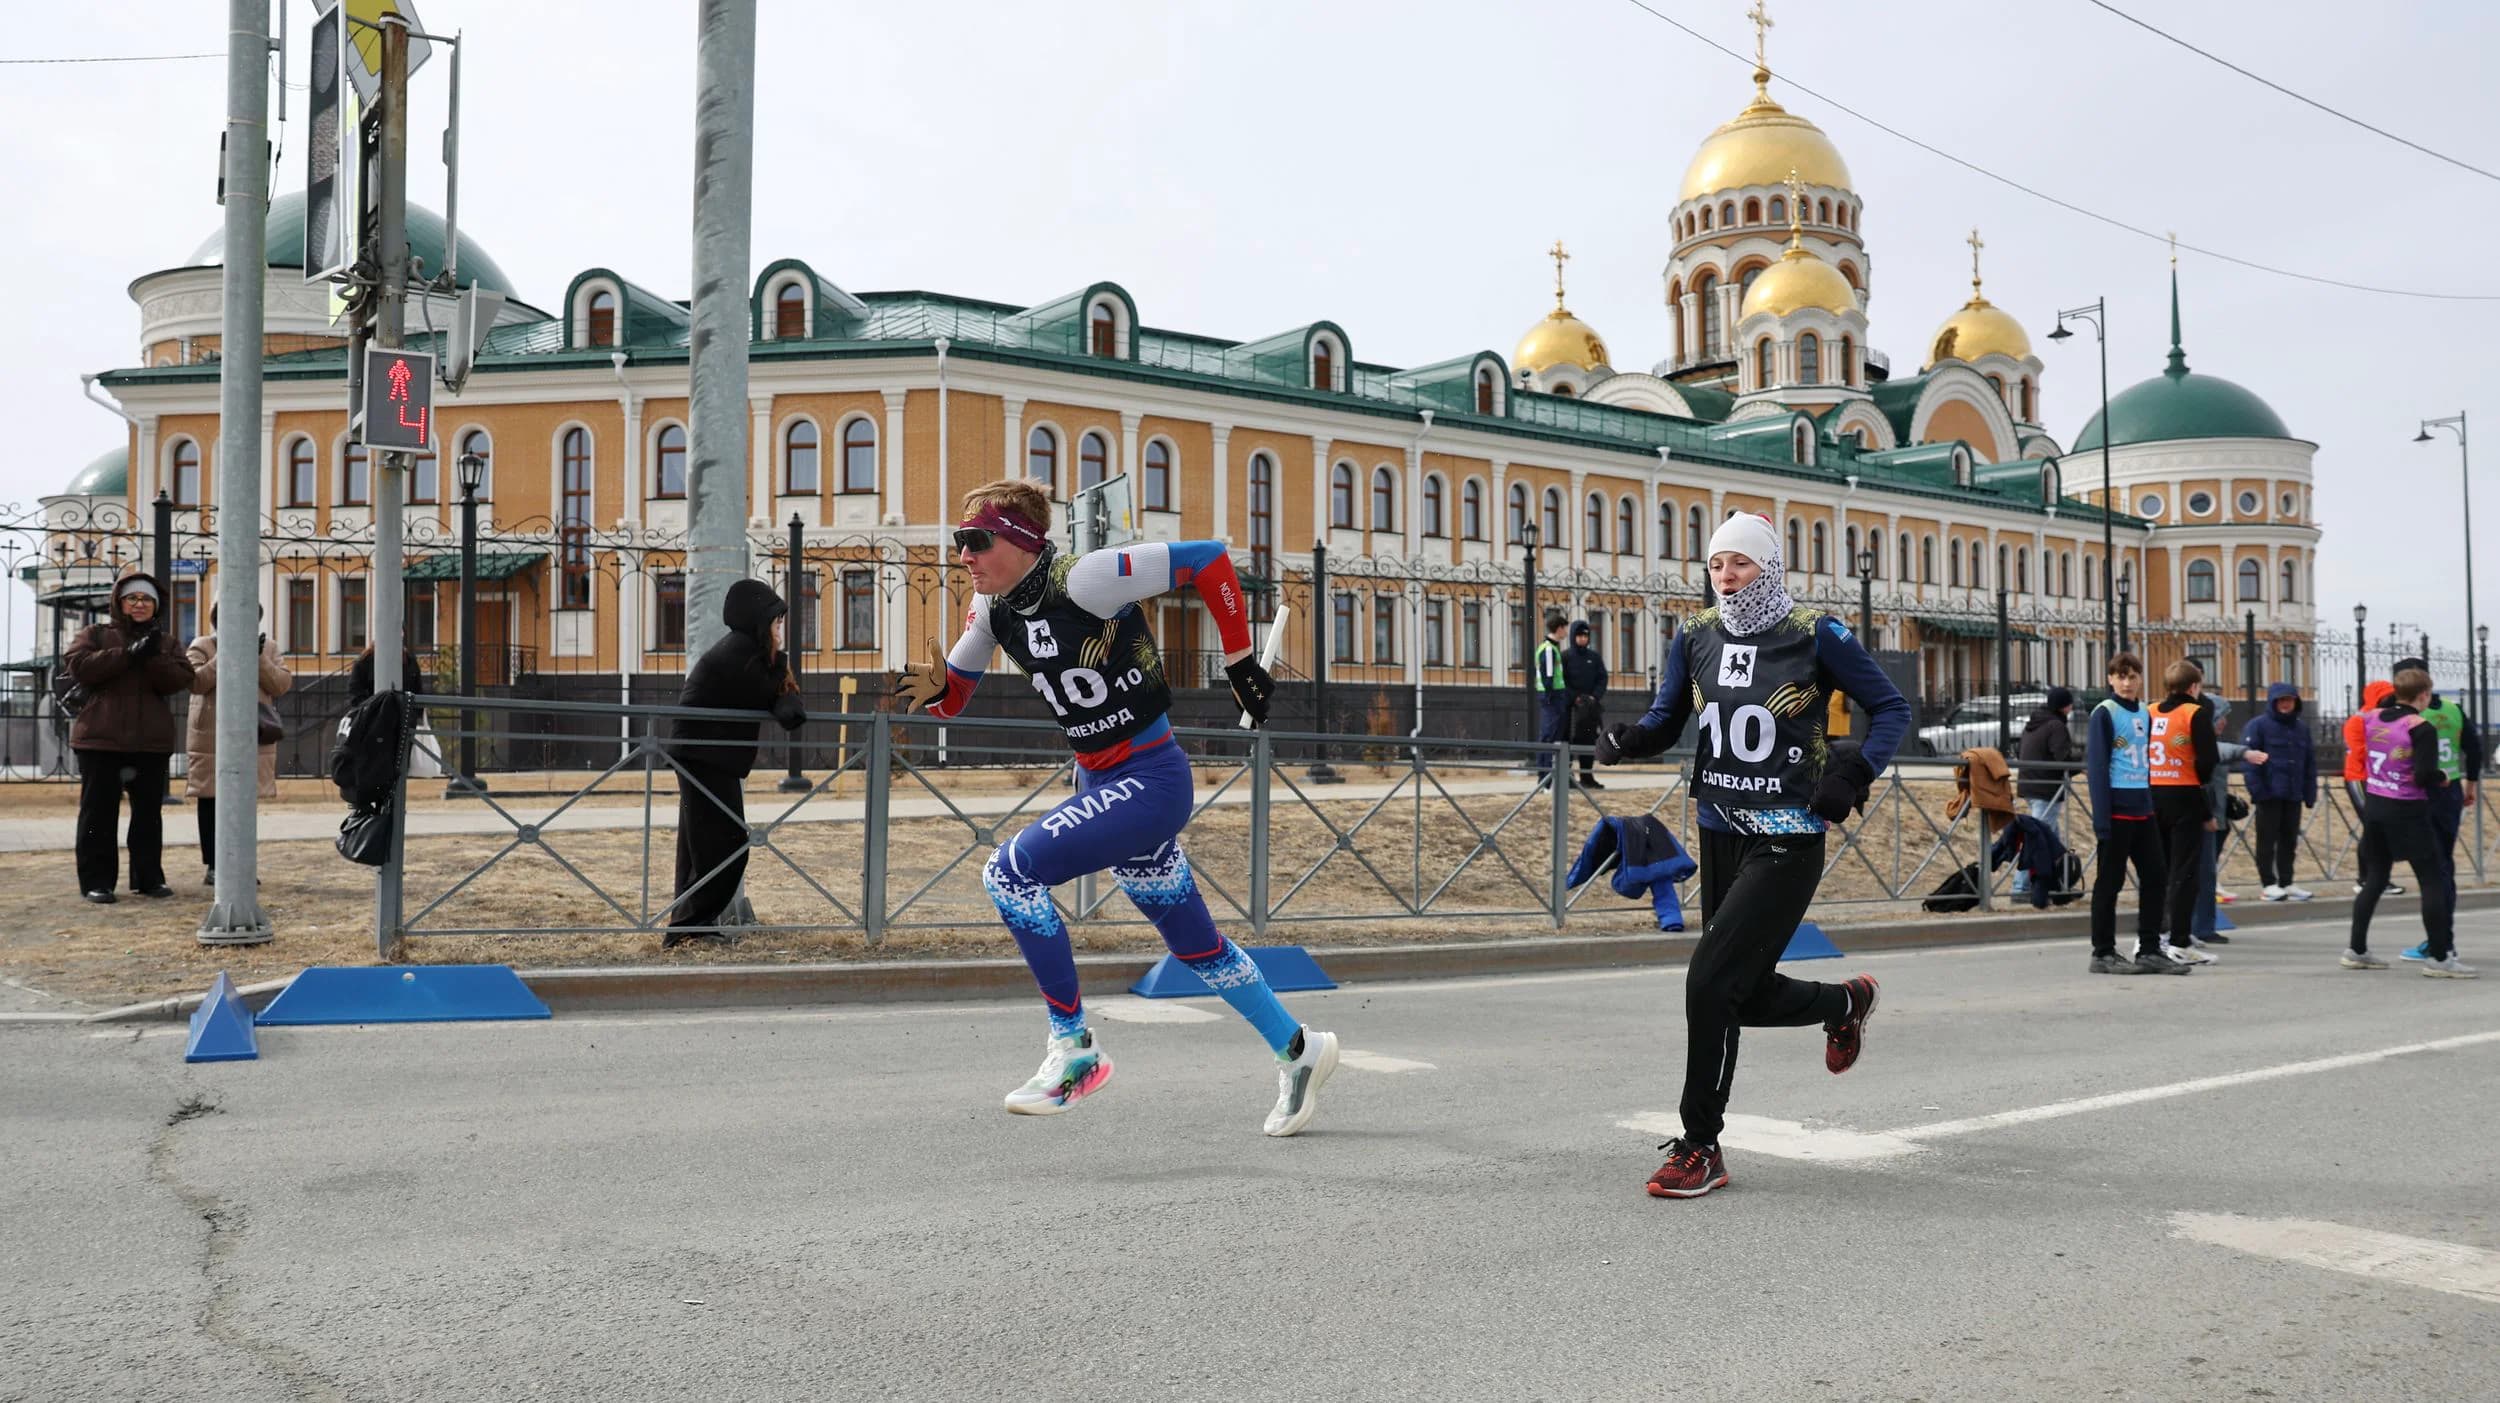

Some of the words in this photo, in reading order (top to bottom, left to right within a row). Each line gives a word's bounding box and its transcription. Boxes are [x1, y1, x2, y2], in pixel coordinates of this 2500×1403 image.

[399, 405, 426, 445] 4
[1032, 667, 1108, 716] 10
[1115, 667, 1142, 692] 10
[1063, 707, 1135, 738] ЛЕХАРД
[1699, 702, 1777, 763] 10
[1788, 746, 1803, 764] 9
[2150, 741, 2167, 766] 3
[2368, 750, 2387, 775] 7
[1702, 769, 1782, 794] САЛЕХАРД
[1041, 777, 1145, 839] ЯМАЛ
